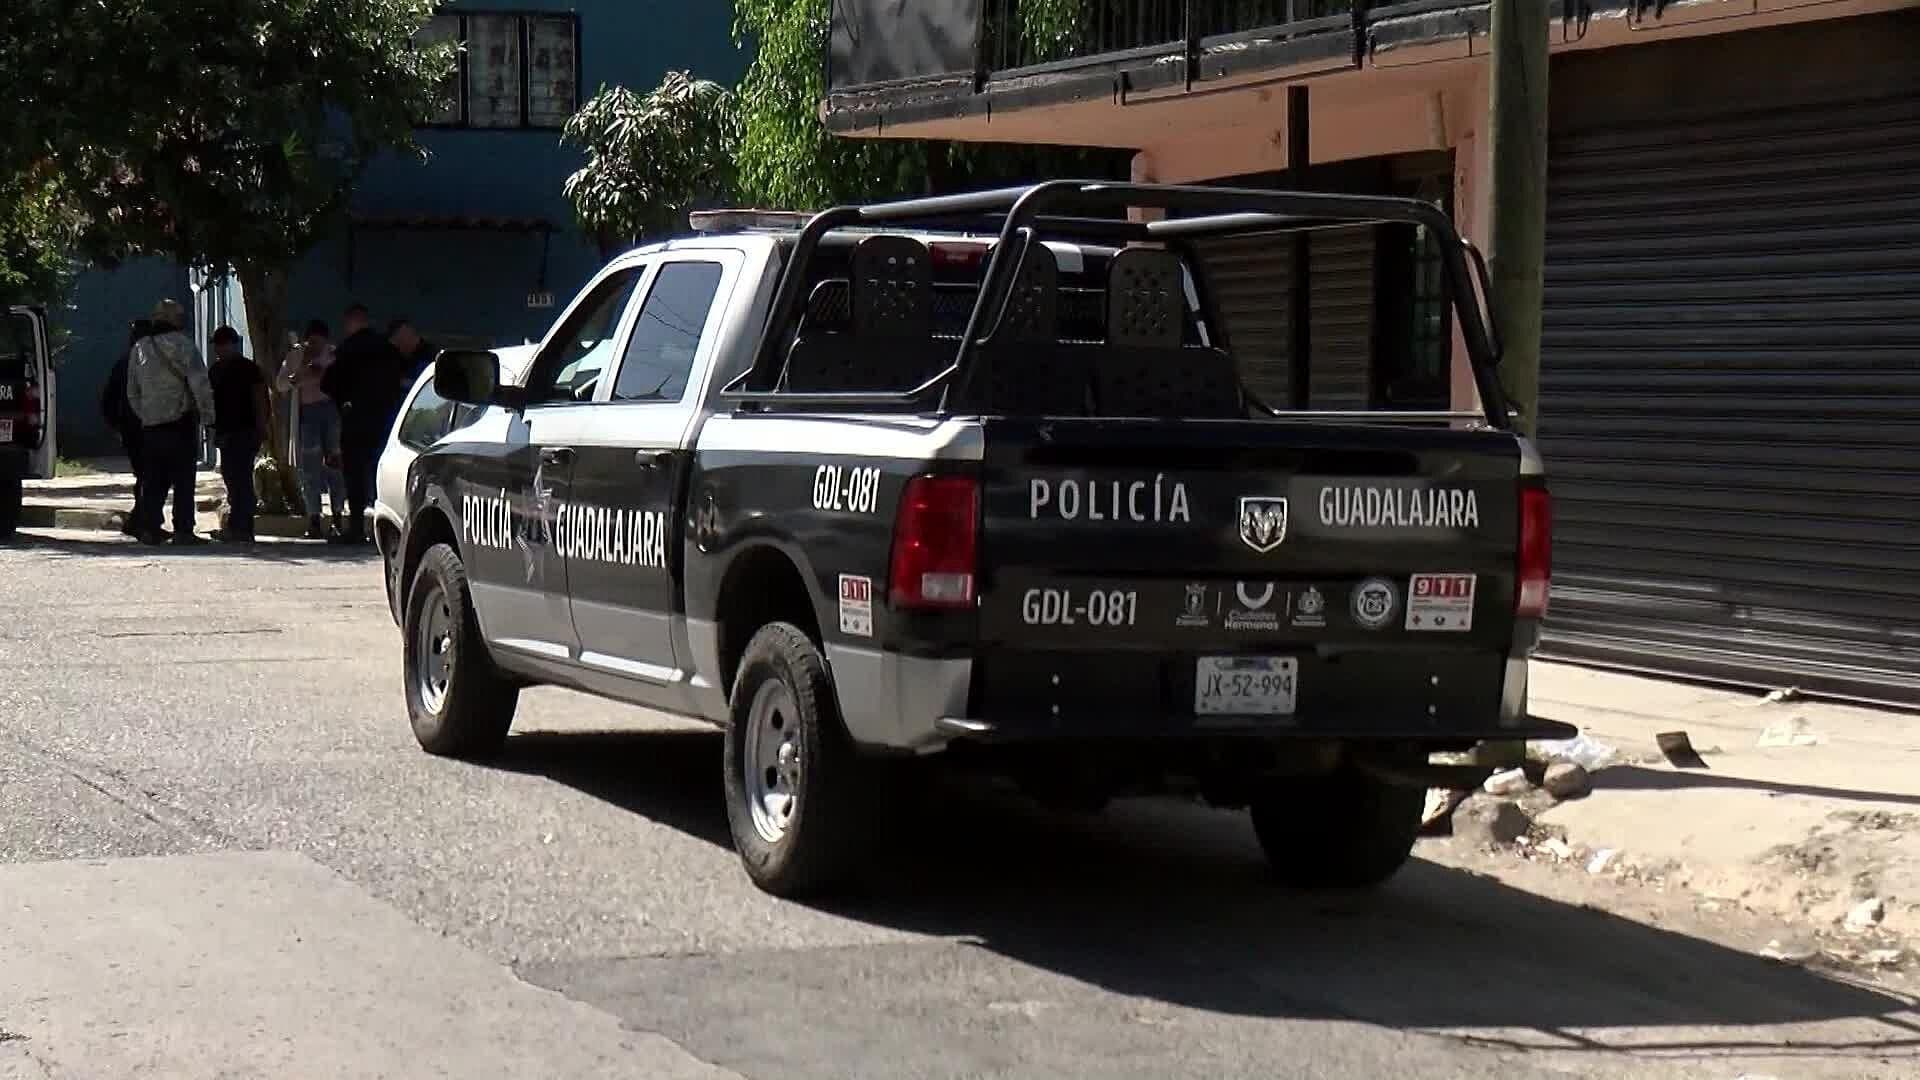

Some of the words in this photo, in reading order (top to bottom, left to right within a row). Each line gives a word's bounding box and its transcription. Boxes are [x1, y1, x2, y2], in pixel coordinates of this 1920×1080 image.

[813, 464, 881, 513] GDL-081
[1030, 472, 1190, 522] POLICÍA
[1319, 487, 1479, 528] GUADALAJARA
[463, 487, 512, 550] POLICÍA
[556, 503, 665, 568] GUADALAJARA
[842, 580, 868, 600] 911
[1416, 579, 1467, 595] 911
[1022, 588, 1137, 625] GDL-081
[1201, 672, 1292, 697] JX-52-994
